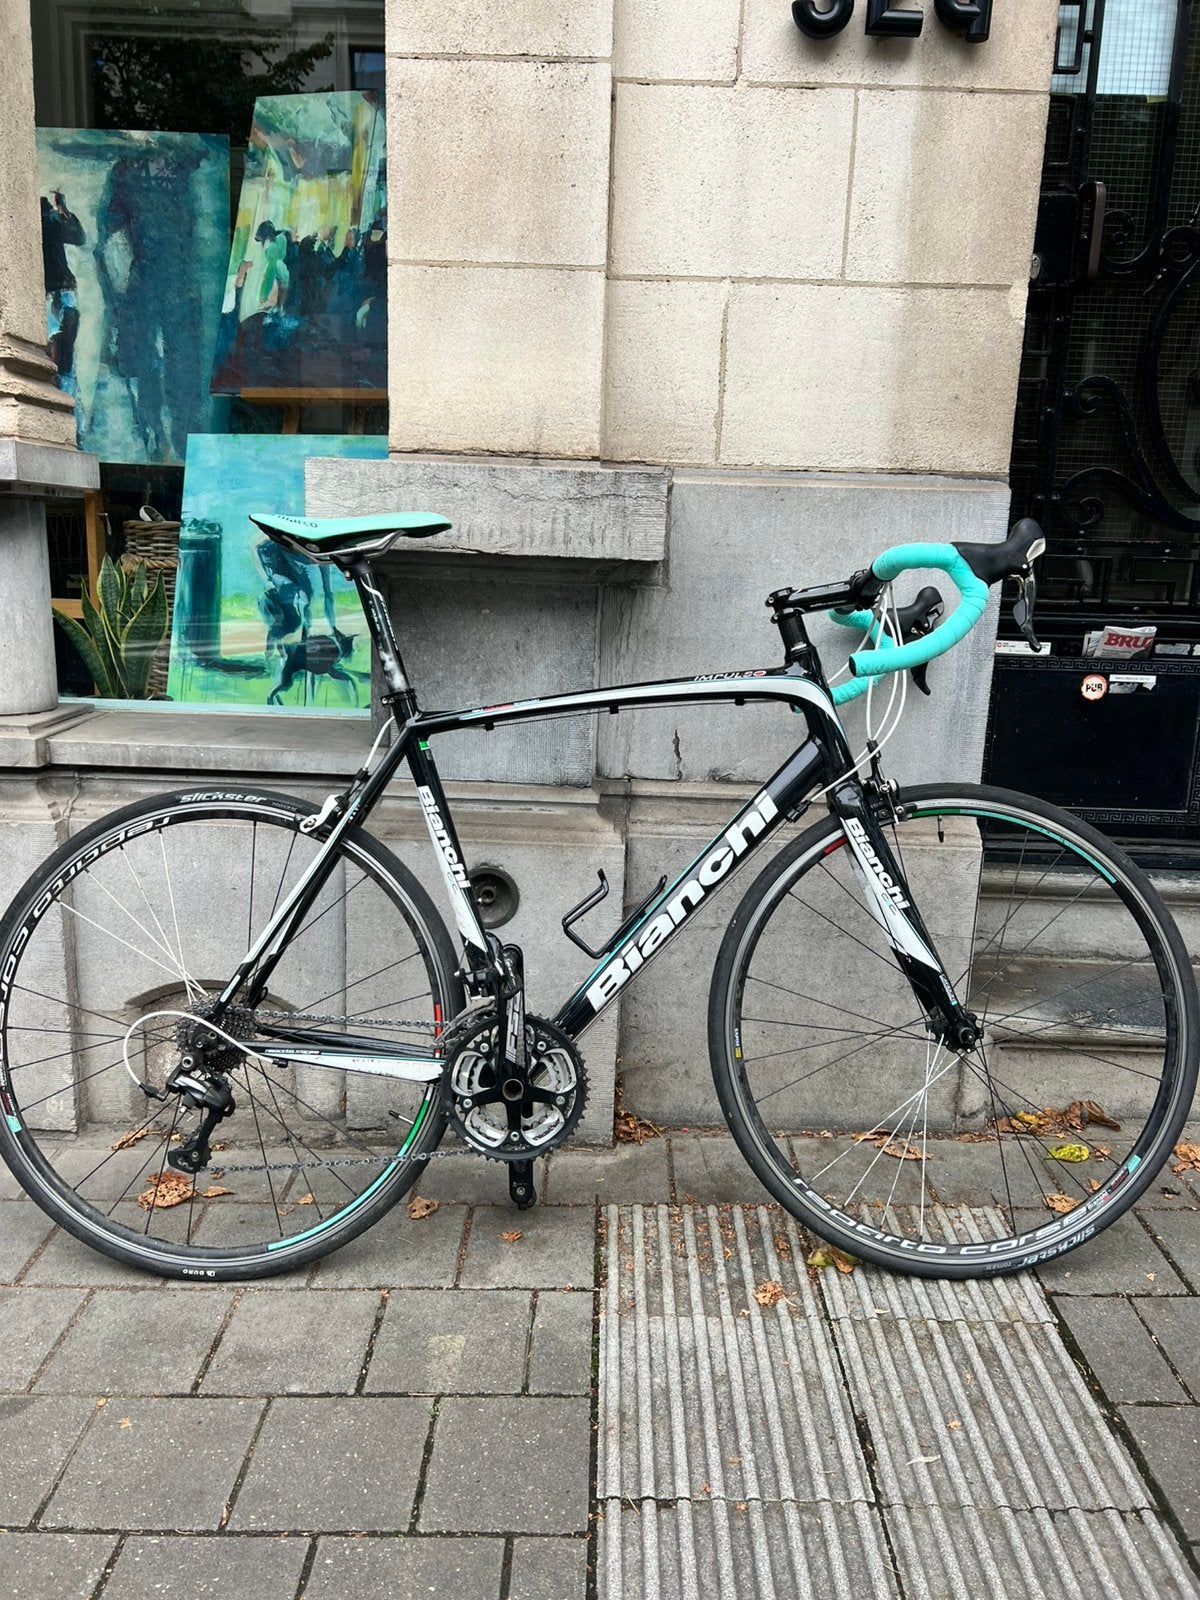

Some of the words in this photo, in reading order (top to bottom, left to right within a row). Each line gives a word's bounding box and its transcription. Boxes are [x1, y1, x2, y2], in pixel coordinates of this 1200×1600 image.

[694, 670, 767, 682] IMPULSO
[178, 791, 268, 803] slickster
[417, 785, 472, 889] Bianchi
[845, 817, 911, 909] Bianchi
[585, 789, 779, 1012] Bianchi
[793, 1177, 946, 1254] reparto
[959, 1206, 1088, 1255] corse
[1017, 1223, 1097, 1267] slickster
